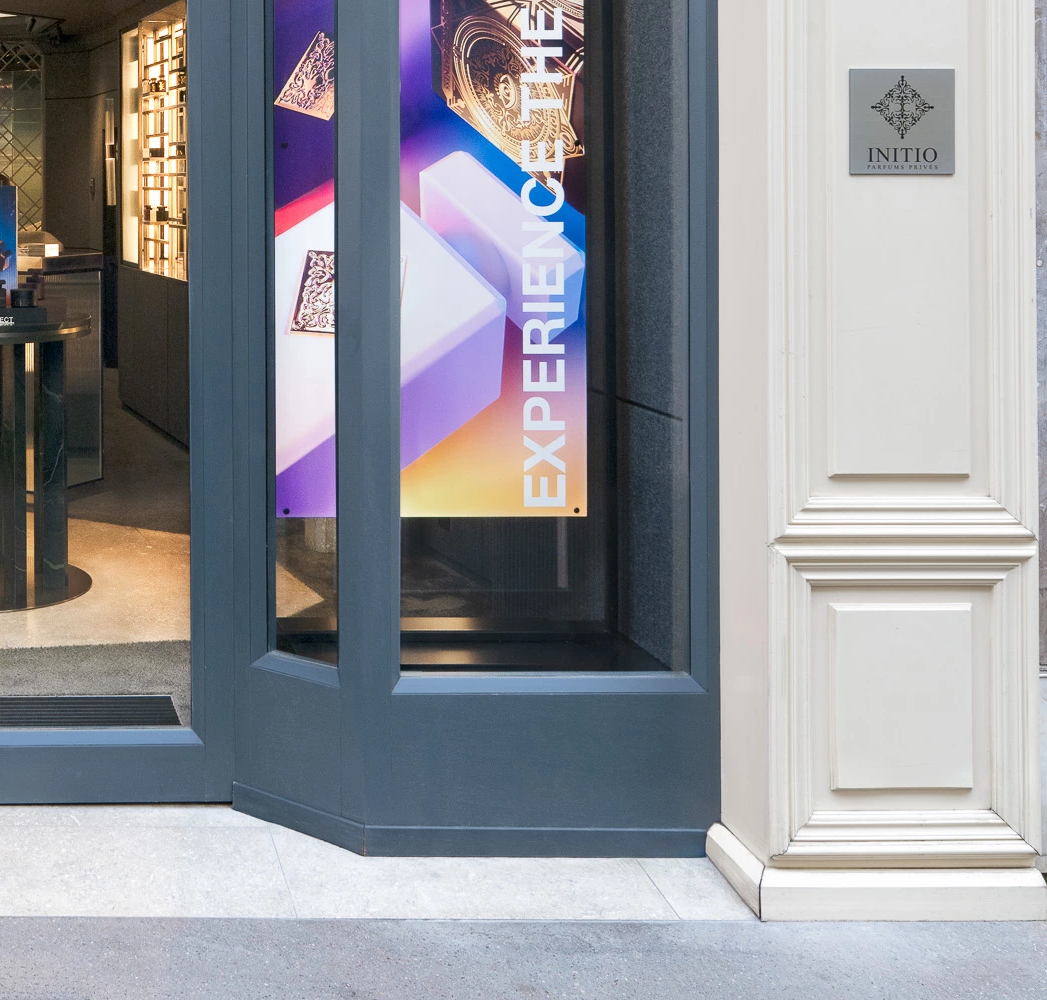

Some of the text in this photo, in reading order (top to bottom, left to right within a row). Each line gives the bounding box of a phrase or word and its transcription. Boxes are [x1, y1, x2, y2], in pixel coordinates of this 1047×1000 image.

[520, 8, 563, 122] THE
[868, 147, 938, 163] INITIO
[520, 139, 566, 508] EXPERIENCE
